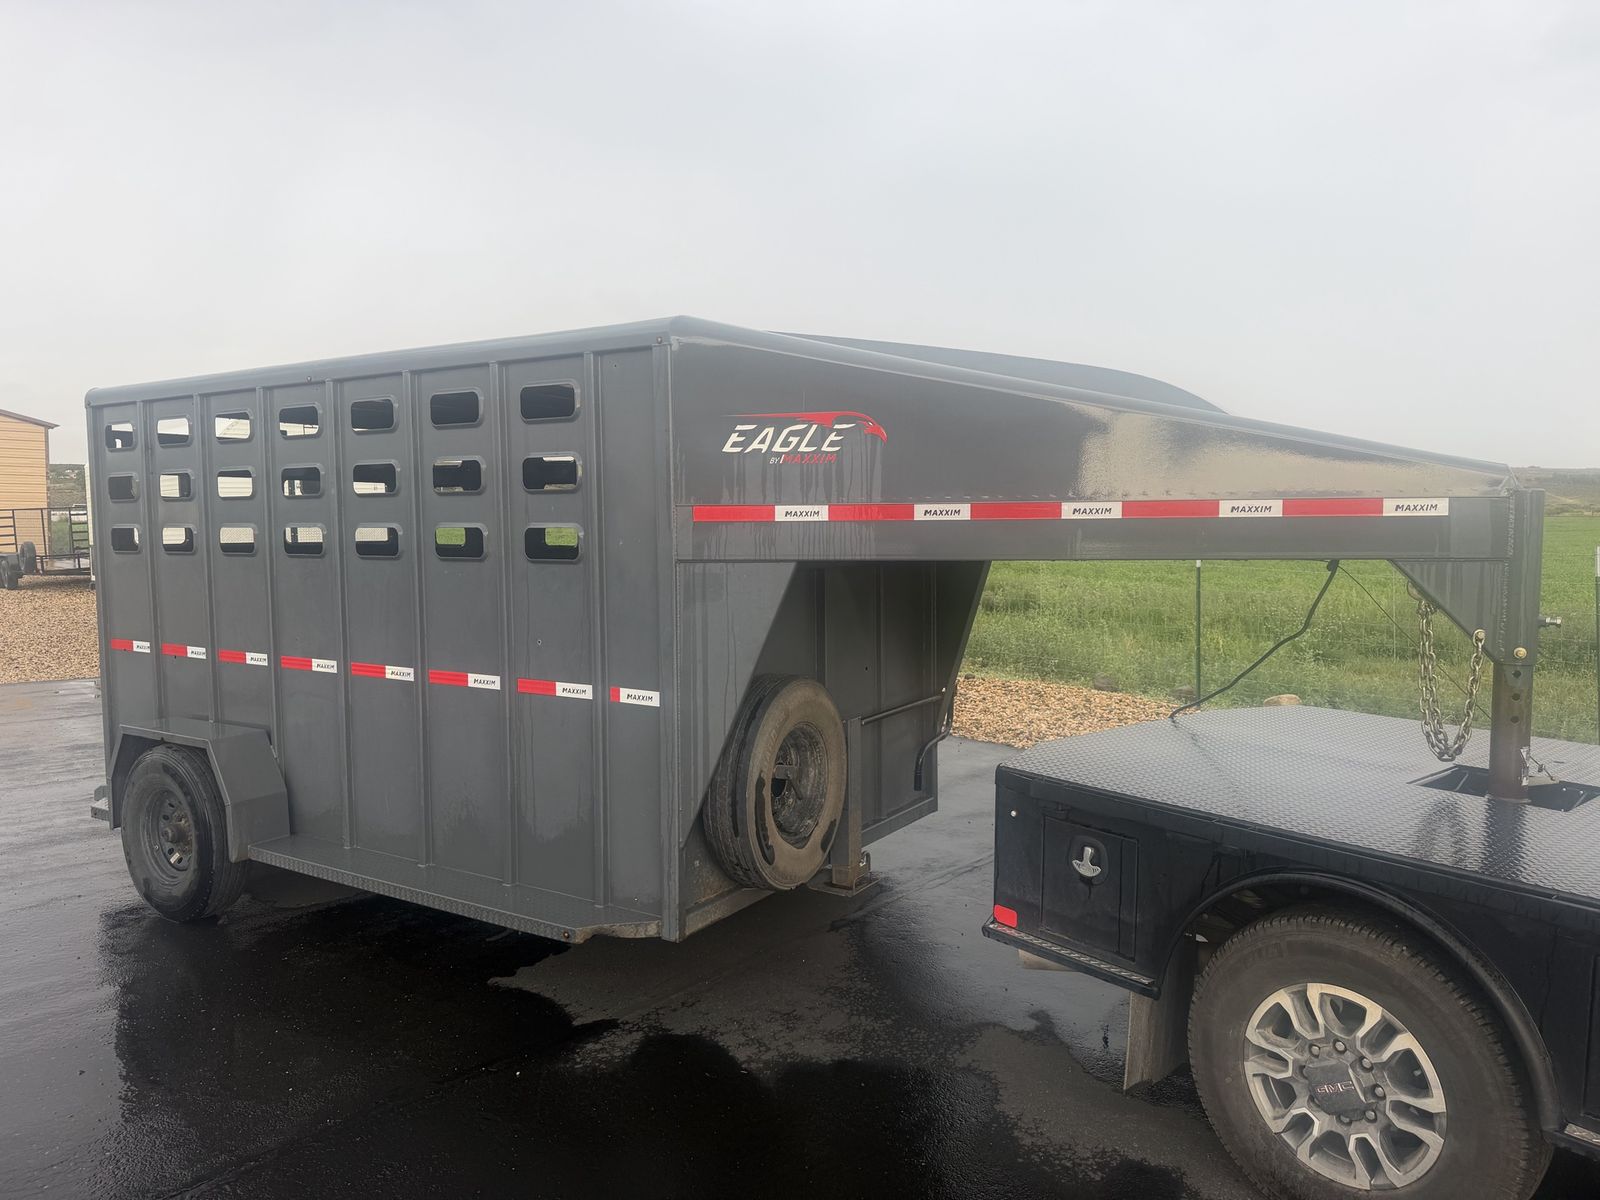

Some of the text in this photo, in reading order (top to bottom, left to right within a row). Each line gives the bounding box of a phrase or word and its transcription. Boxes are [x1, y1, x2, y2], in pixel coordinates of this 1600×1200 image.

[722, 424, 856, 454] EAGLE
[780, 454, 837, 465] MAXXIM
[1072, 507, 1112, 515] MAXXIM
[1230, 505, 1272, 513] MAXXIM
[1394, 503, 1438, 512] MAXXIM
[784, 510, 820, 518] MAXXIM
[390, 670, 411, 678] MAXXIM
[473, 678, 496, 686] MAXXIM
[562, 687, 587, 695] MAXXIM
[626, 693, 653, 702] MAXXIM
[1317, 1081, 1355, 1093] GMC
